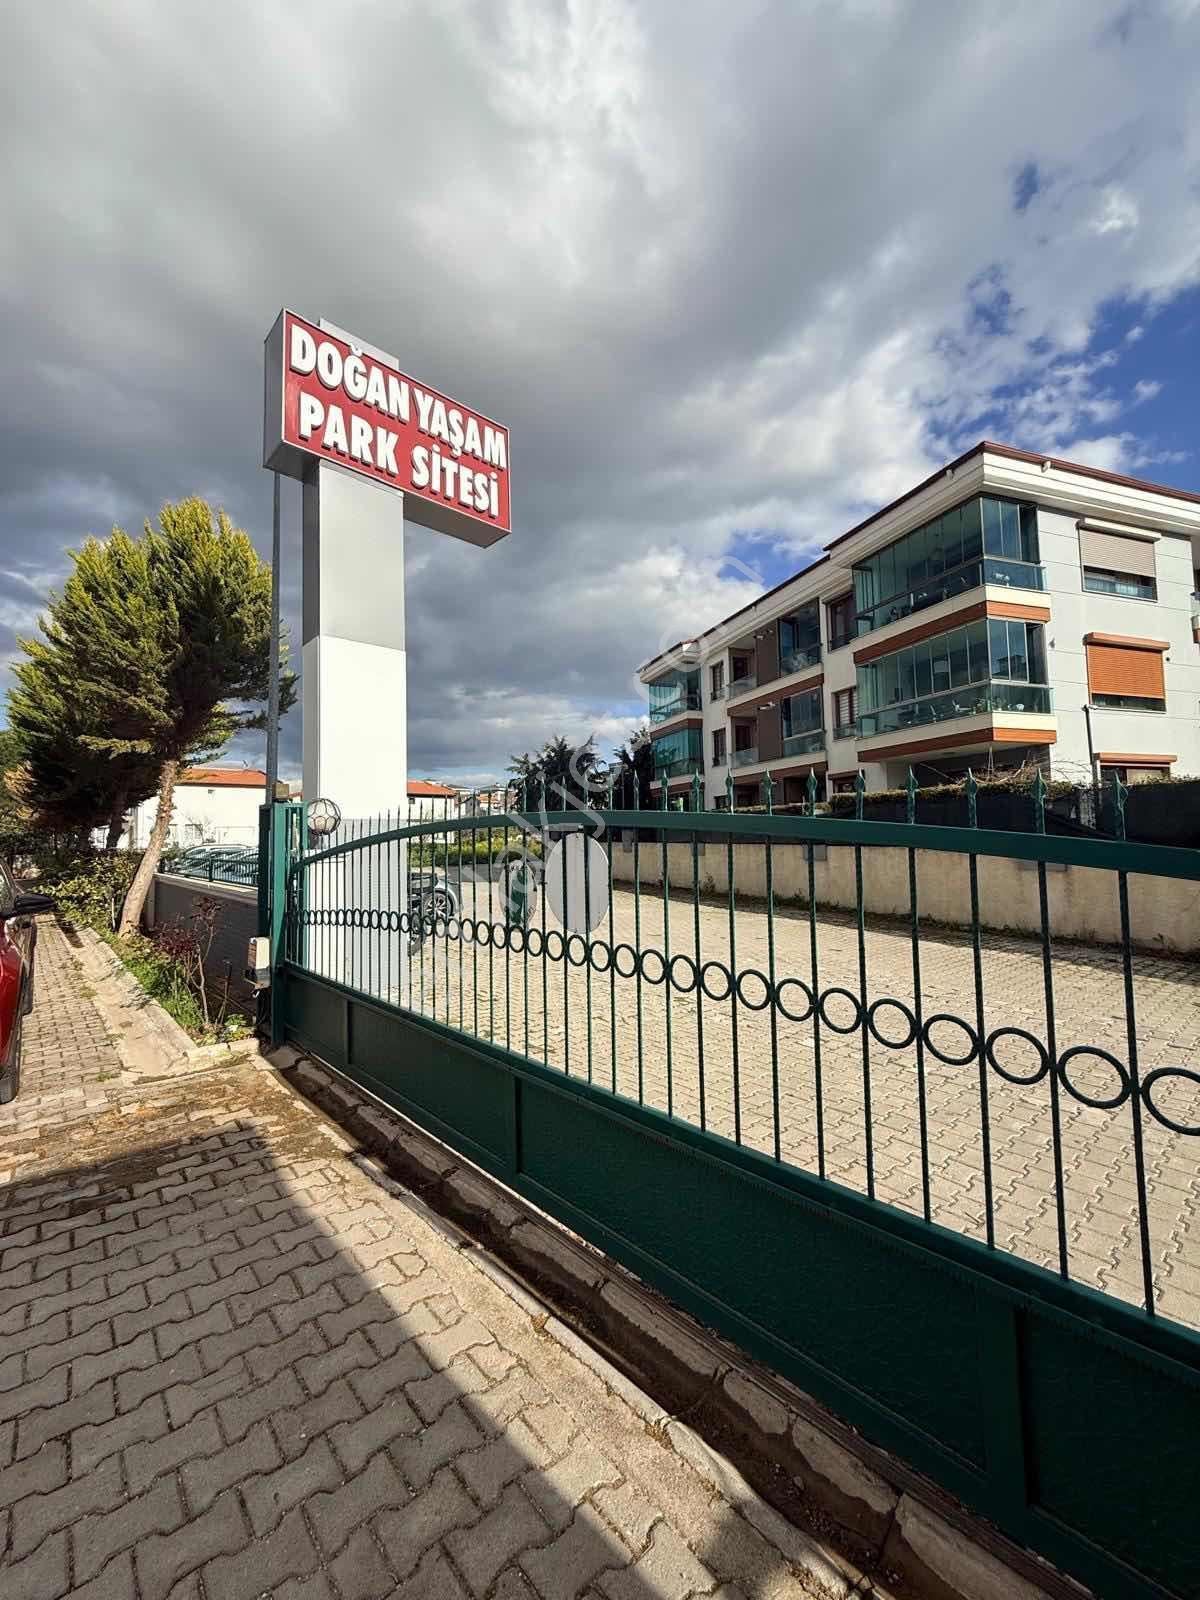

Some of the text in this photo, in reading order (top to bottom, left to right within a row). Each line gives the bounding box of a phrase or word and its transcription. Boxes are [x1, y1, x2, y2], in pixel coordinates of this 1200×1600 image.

[290, 323, 506, 471] DOĞAN YAŞAM
[299, 391, 498, 518] PARK SİTESİ
